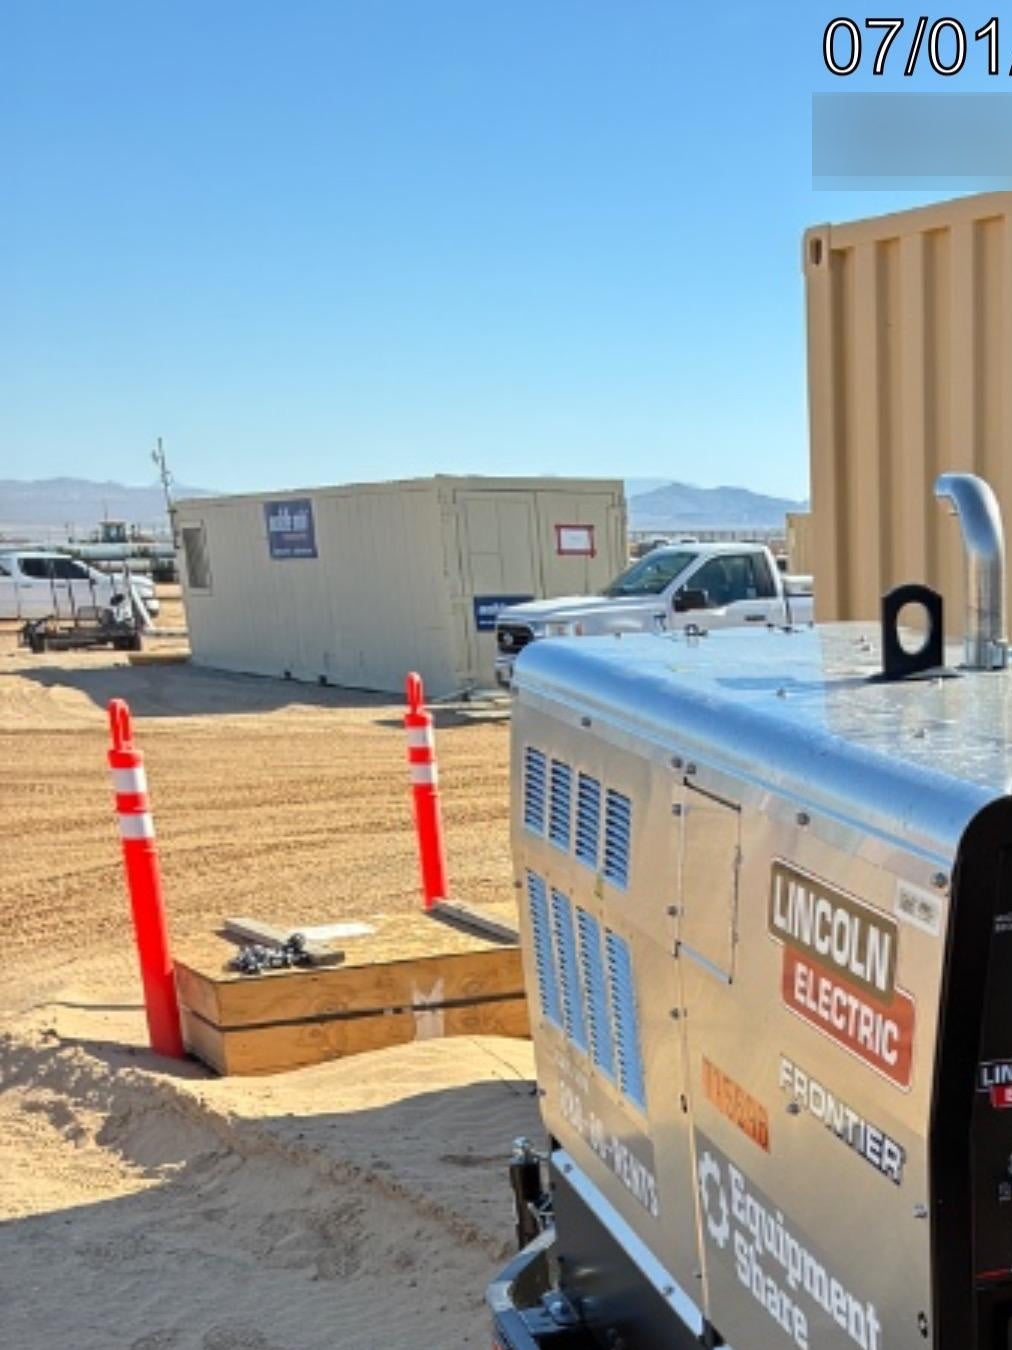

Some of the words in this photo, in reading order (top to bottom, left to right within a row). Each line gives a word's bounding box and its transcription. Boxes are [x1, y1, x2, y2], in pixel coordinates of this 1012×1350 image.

[773, 875, 892, 993] LINCOLN
[793, 962, 899, 1066] ELECTRIC
[778, 1056, 905, 1185] FRONTIER
